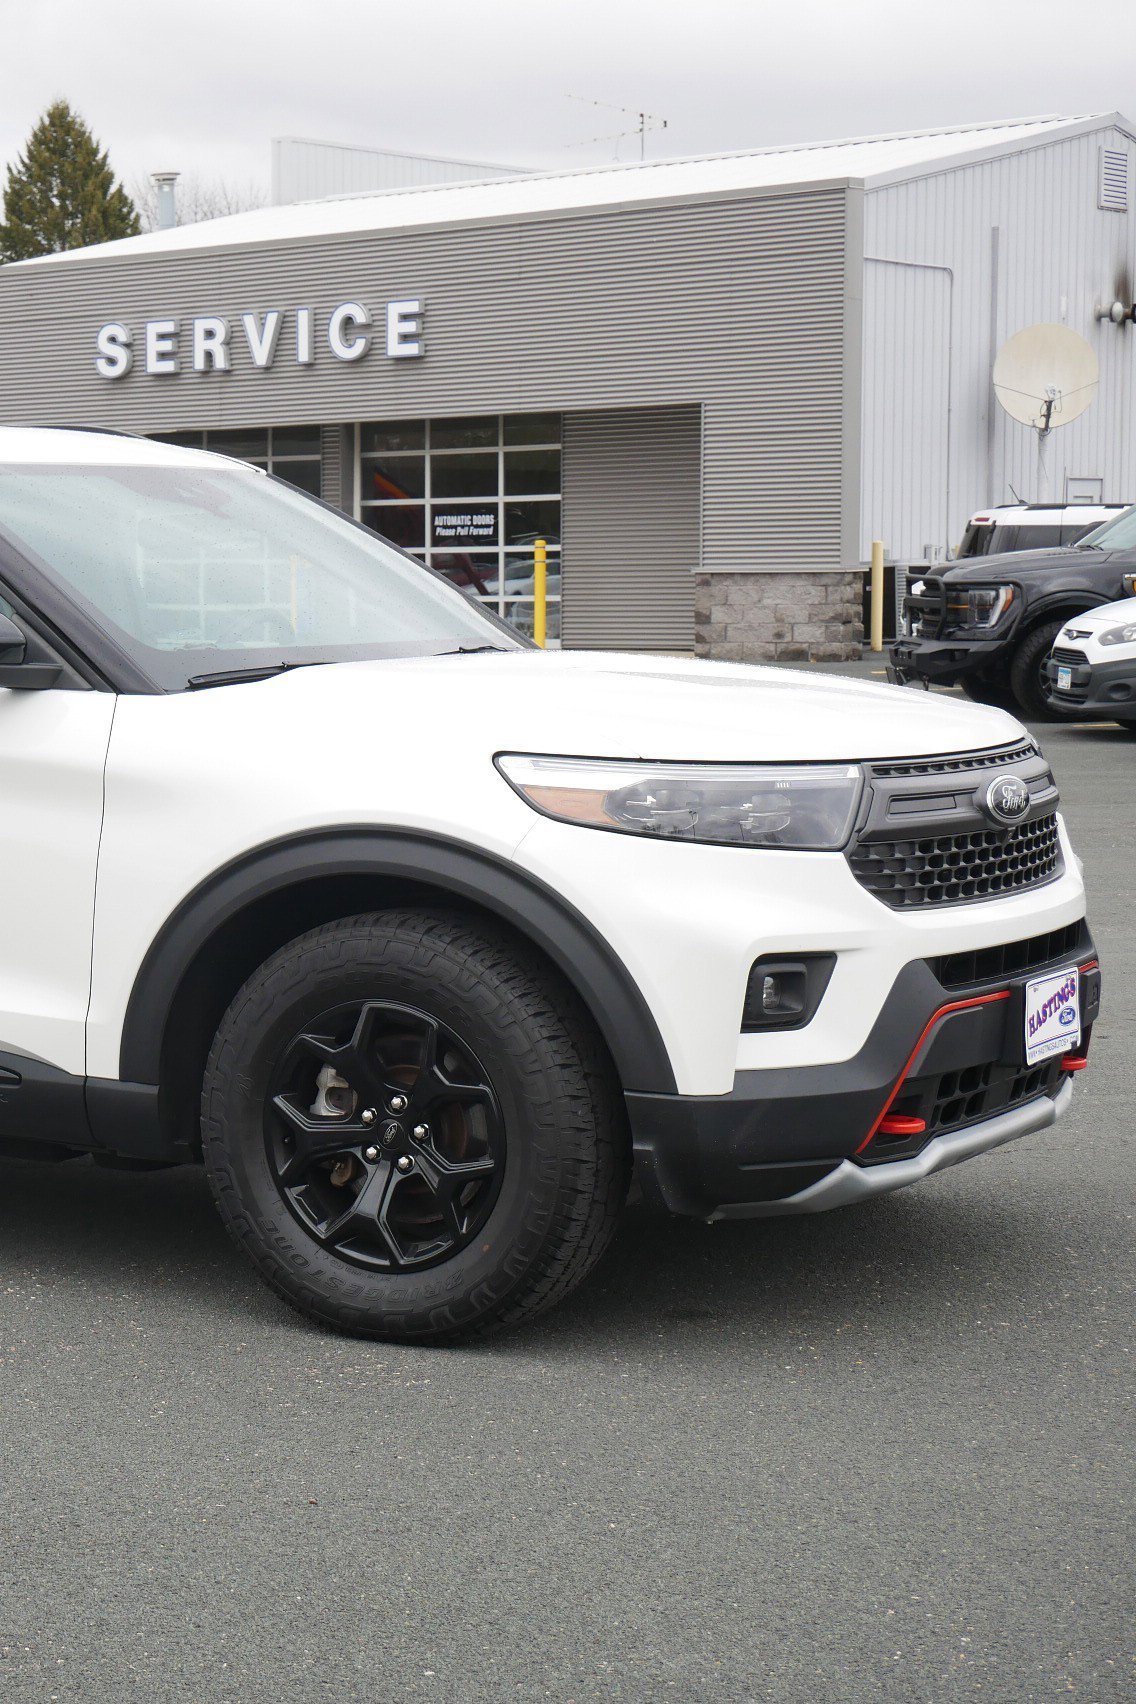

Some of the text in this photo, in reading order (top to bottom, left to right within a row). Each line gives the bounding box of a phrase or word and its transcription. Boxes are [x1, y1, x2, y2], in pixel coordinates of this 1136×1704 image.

[96, 299, 424, 379] SERVICE
[434, 514, 494, 525] AUTOMATIC DOORS
[435, 526, 493, 536] Please Pull Forward
[1002, 785, 1025, 811] Ford
[1028, 976, 1076, 1037] HASTINGS
[257, 1216, 464, 1299] BRIDGESTONE
